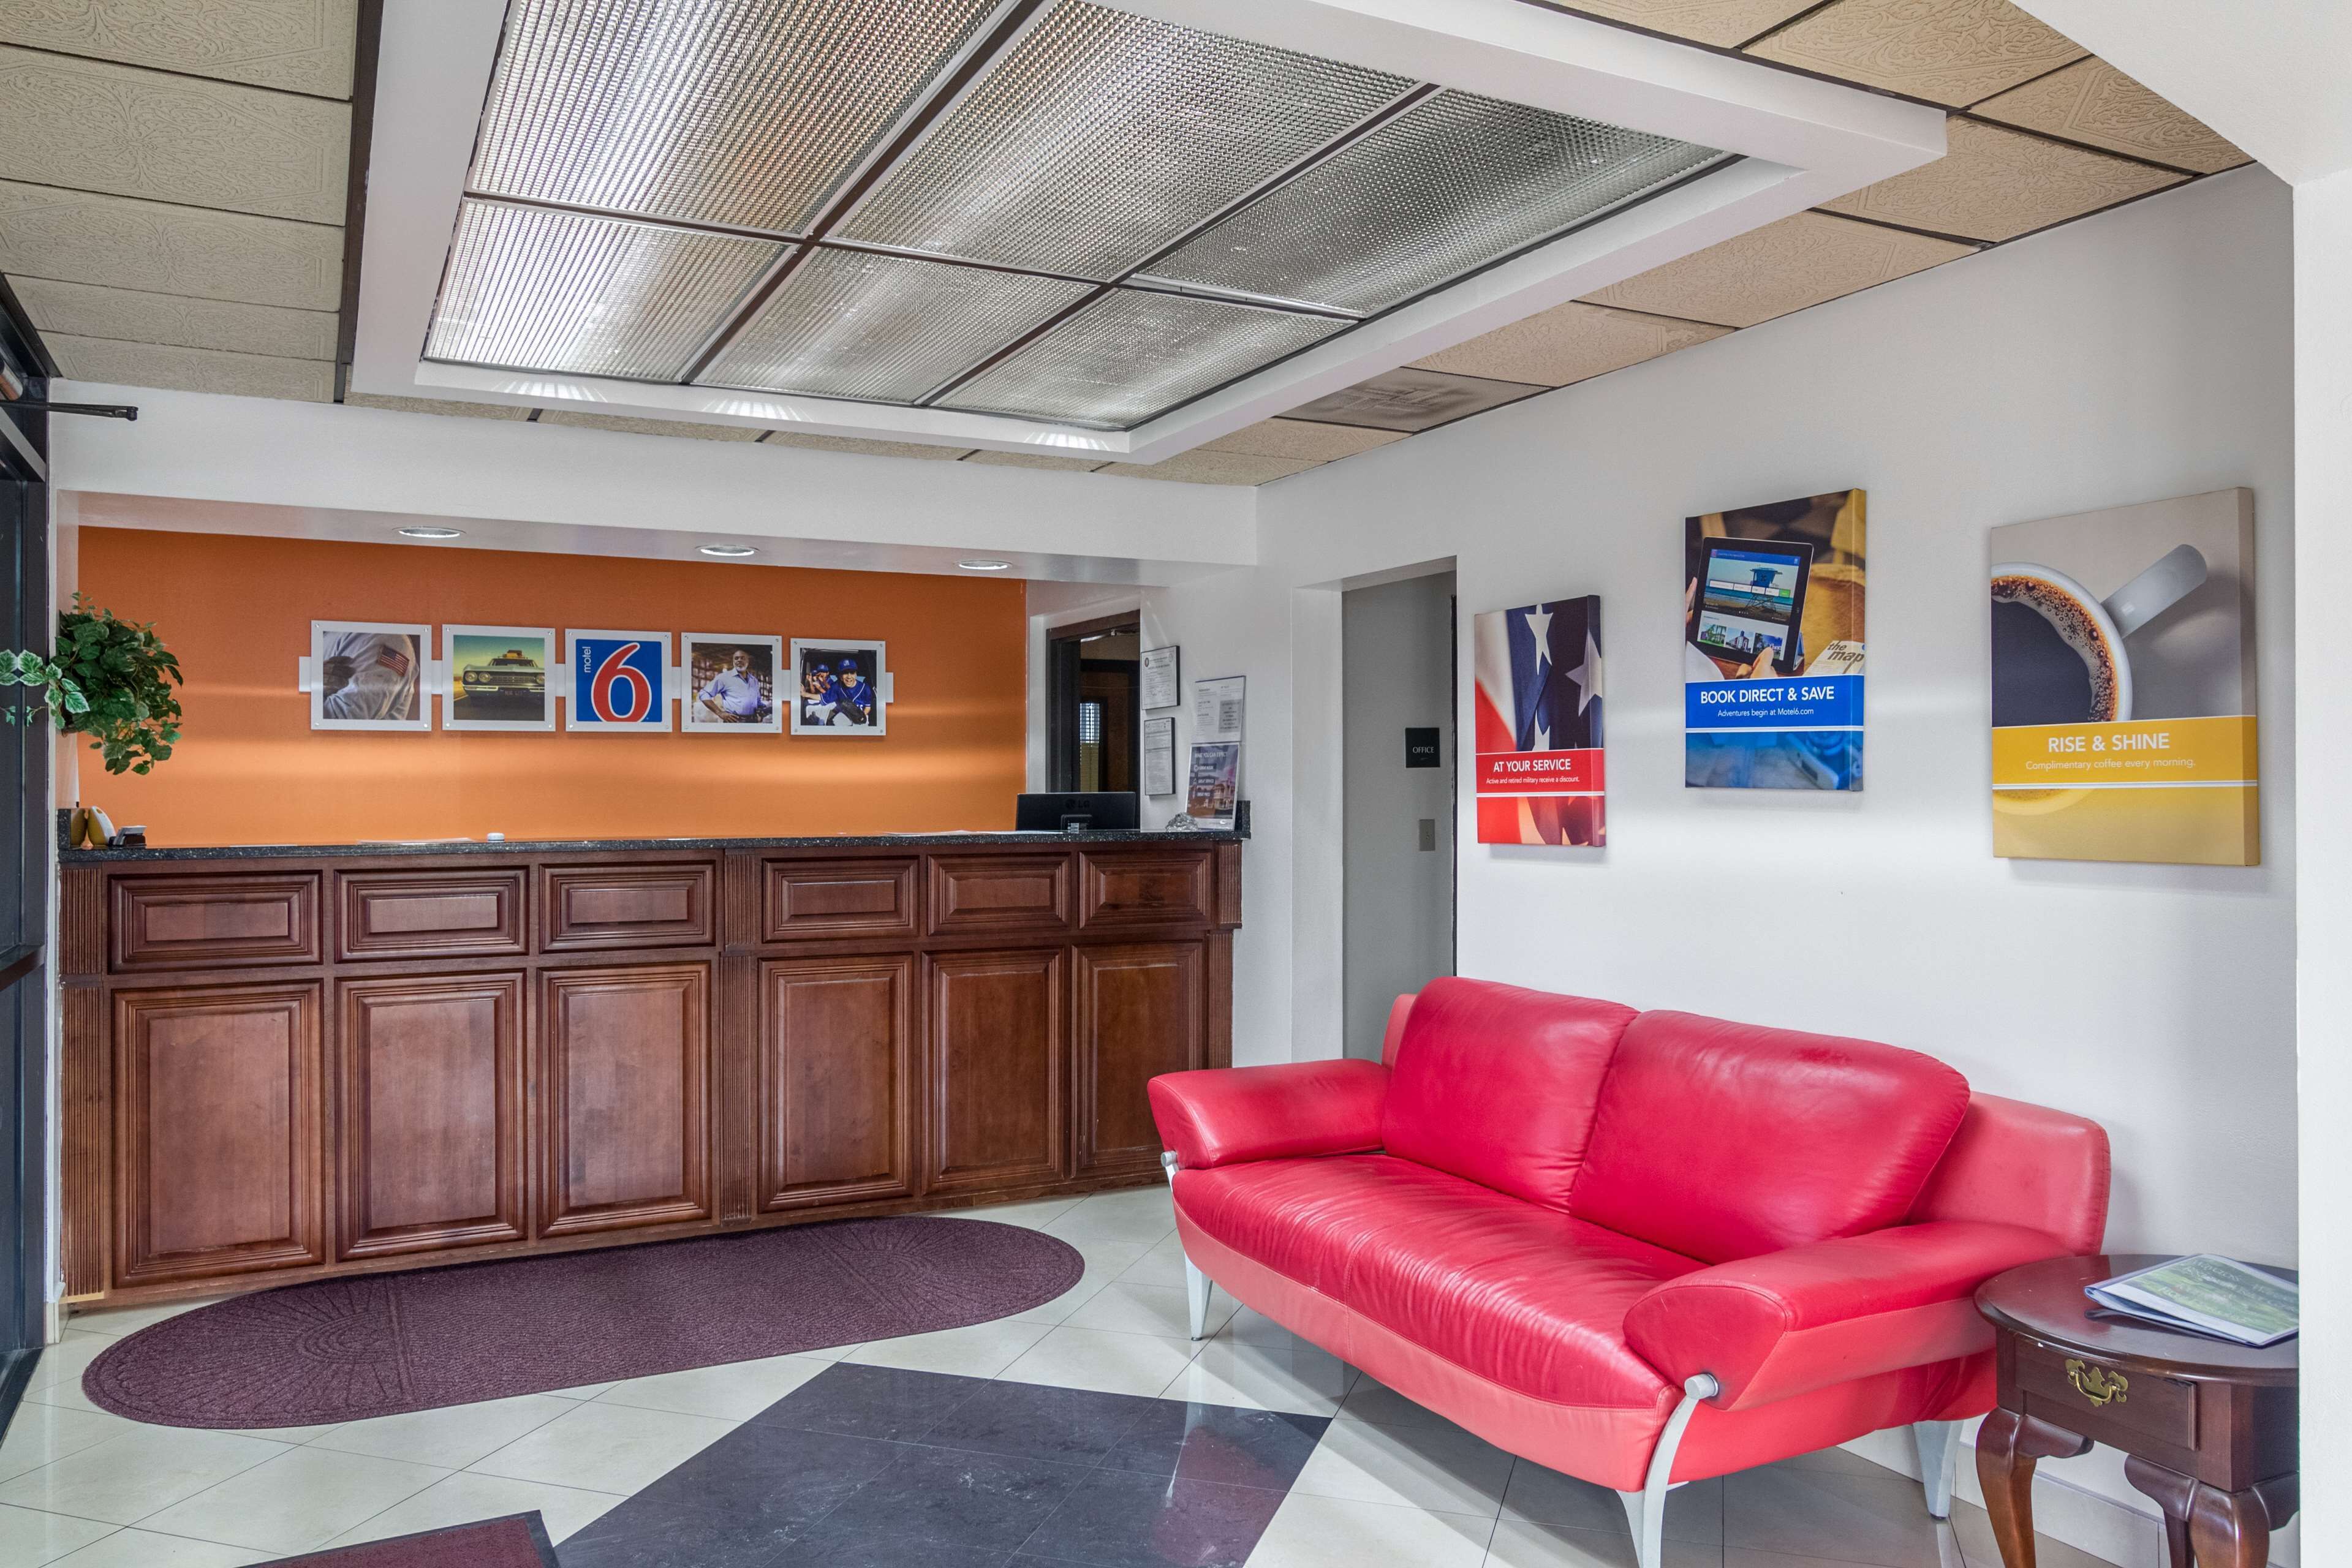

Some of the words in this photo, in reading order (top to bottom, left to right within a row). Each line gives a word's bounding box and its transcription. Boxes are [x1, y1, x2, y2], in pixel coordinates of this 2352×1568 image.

[1827, 641, 1847, 650] the
[1827, 651, 1865, 674] map
[582, 646, 591, 673] motel
[591, 643, 652, 723] 6
[1700, 690, 1736, 704] BOOK
[1739, 688, 1784, 703] DIRECT
[1787, 687, 1798, 701] &
[1801, 686, 1835, 700] SAVE
[1751, 709, 1768, 717] begin
[1777, 707, 1814, 716] Motel6.com
[2048, 736, 2086, 752] RISE
[2092, 735, 2105, 752] &
[2112, 733, 2170, 750] SHINE
[1493, 761, 1504, 772] AT
[1506, 760, 1530, 772] YOUR
[1533, 758, 1571, 771] SERVICE
[2025, 760, 2091, 772] Complimentary
[2093, 758, 2122, 769] coffee
[2125, 760, 2150, 769] every
[2153, 758, 2196, 768] morning.
